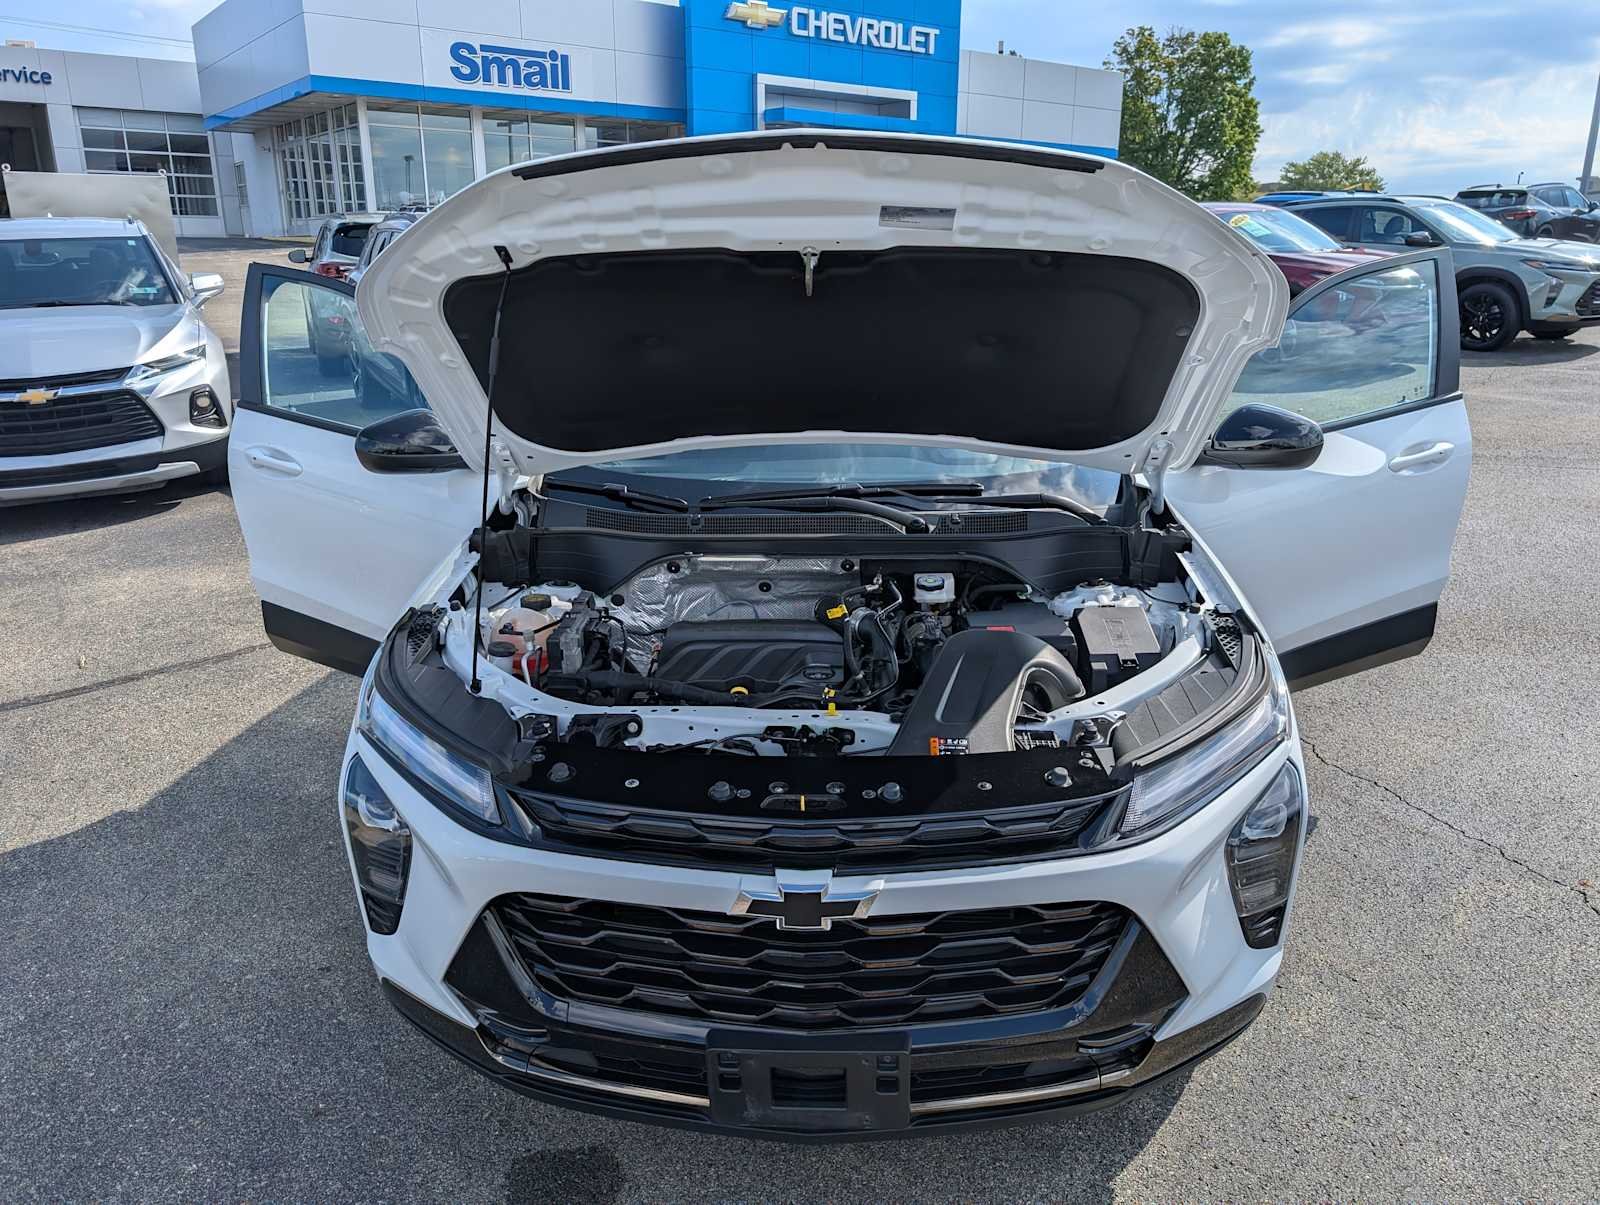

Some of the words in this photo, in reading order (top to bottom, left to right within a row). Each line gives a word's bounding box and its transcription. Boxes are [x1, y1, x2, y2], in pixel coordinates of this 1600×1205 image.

[791, 6, 940, 55] CHEVROLET
[0, 66, 52, 85] rvice
[449, 41, 571, 91] Smail
